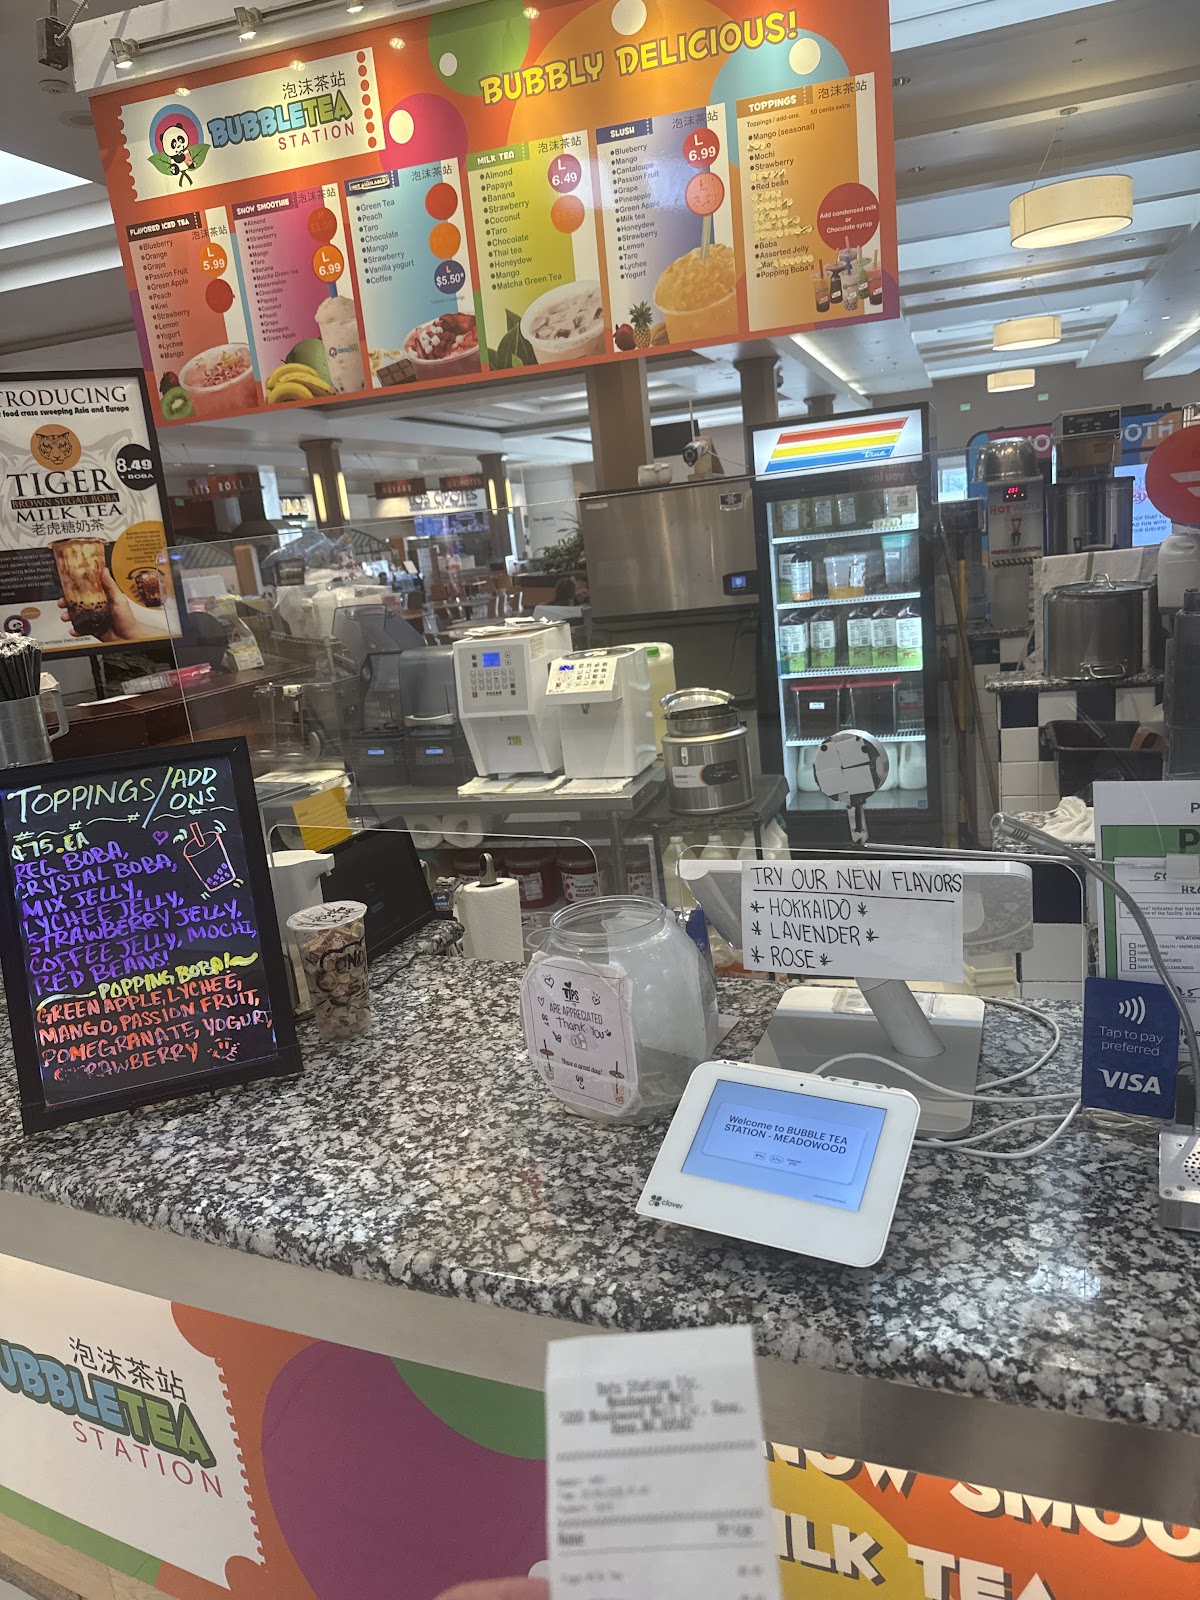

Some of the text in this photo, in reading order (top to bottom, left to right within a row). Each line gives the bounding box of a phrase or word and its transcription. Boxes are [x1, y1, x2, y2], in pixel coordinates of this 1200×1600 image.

[480, 9, 798, 105] BUBBLY DELICIOUS!
[282, 71, 346, 100] 泡沫茶站
[818, 80, 867, 99] 泡沫茶站
[748, 94, 797, 113] TOPPINGS
[672, 110, 718, 129] 泡沫茶站
[278, 121, 354, 150] STATION
[610, 126, 635, 139] SLUSH
[753, 122, 815, 141] Mango (seasonal)
[538, 135, 582, 154] 泡沫茶站
[614, 143, 647, 156] Blueberry
[477, 150, 515, 166] MILK TEA
[616, 156, 638, 166] Mango
[688, 146, 716, 161] 6.99
[754, 151, 775, 161] Mochi
[616, 162, 655, 175] Cantaloupe
[755, 158, 794, 171] Strawberry
[411, 164, 453, 182] 泡沫茶站
[484, 168, 513, 180] Almond
[552, 171, 577, 186] 6.49
[486, 180, 513, 191] Papaya
[487, 191, 515, 203] Banana
[236, 205, 255, 215] SNOW
[360, 199, 395, 212] Green Tea
[488, 200, 530, 214] Strawberry
[819, 212, 832, 220] Add
[832, 206, 864, 218] condensed
[362, 212, 383, 222] Peach
[489, 213, 521, 224] Coconut
[130, 218, 190, 236] FLAVORED ICED TEA
[191, 225, 228, 240] 泡沫茶站
[363, 224, 379, 233] Taro
[621, 221, 655, 233] Honeydew
[826, 221, 873, 234] Chocolate syrup
[365, 231, 399, 243] Chocolate
[622, 229, 658, 242] Strawberry
[143, 240, 173, 251] Blueberry
[366, 244, 389, 254] Mango
[759, 240, 778, 250] Boba
[760, 245, 809, 260] Assorted Jelly
[145, 251, 168, 261] Orange
[367, 251, 405, 264] Strawberry
[494, 256, 532, 269] Honeydew
[147, 262, 166, 271] Grape
[203, 259, 225, 270] 5.99
[318, 262, 341, 276] 6.99
[368, 259, 415, 274] Vanilla yogurt
[624, 260, 647, 271] Lychee
[761, 264, 815, 279] Popping Boba's
[370, 275, 393, 285] Coffee
[495, 269, 520, 280] Mango
[497, 271, 562, 290] Matcha Green Tea
[0, 386, 127, 408] RODUCING
[2, 410, 19, 418] food
[40, 407, 73, 416] sweeping
[74, 406, 90, 414] Asia
[91, 405, 104, 413] and
[105, 405, 130, 413] Europe
[862, 450, 887, 458] true
[116, 458, 153, 473] 8.49
[6, 468, 118, 498] TIGER
[12, 493, 118, 509] BROWN SUGAR BOBA
[16, 504, 124, 523] MILK TEA
[32, 518, 105, 536] 老虎糖奶茶
[171, 767, 217, 789] ADD
[169, 786, 217, 810] ONS
[14, 841, 129, 883] REG BOBA,
[16, 853, 178, 899] CRYSTAL BOBA,
[750, 867, 962, 893] TRY OUR NEW FLAVORS
[21, 880, 142, 919] MIX JELLY,
[23, 890, 184, 939] LYCHEE JELLY,
[769, 898, 851, 920] HOKKAIDO
[28, 909, 170, 955] STRAWBERRY
[187, 920, 257, 942] MOCHI,
[770, 921, 860, 946] LAVENDER
[29, 932, 183, 974] COFFEE JELLY,
[771, 946, 816, 968] ROSE
[32, 950, 170, 996] RED BEANS!
[98, 952, 231, 1000] POPPING BOBA!
[37, 973, 242, 1025] GREEN APPLE, LYCHEE,
[562, 987, 580, 1001] TIPS
[39, 989, 260, 1046] MANGO, PASSION FRUIT,
[550, 1002, 603, 1025] ARE APPRECIATED
[41, 1010, 273, 1067] POMEGRANATE, YOGURT,
[1099, 1025, 1164, 1045] Tap to pay
[1101, 1041, 1160, 1057] preferred
[1097, 1068, 1161, 1095] VISA
[729, 1115, 848, 1146] Welcome to BUBBLE TEA
[724, 1123, 767, 1139] STATION
[773, 1134, 847, 1155] MEADOWOOD
[661, 1198, 684, 1210] clover
[69, 1337, 187, 1403] 泡沫茶站
[72, 1420, 223, 1498] STATION
